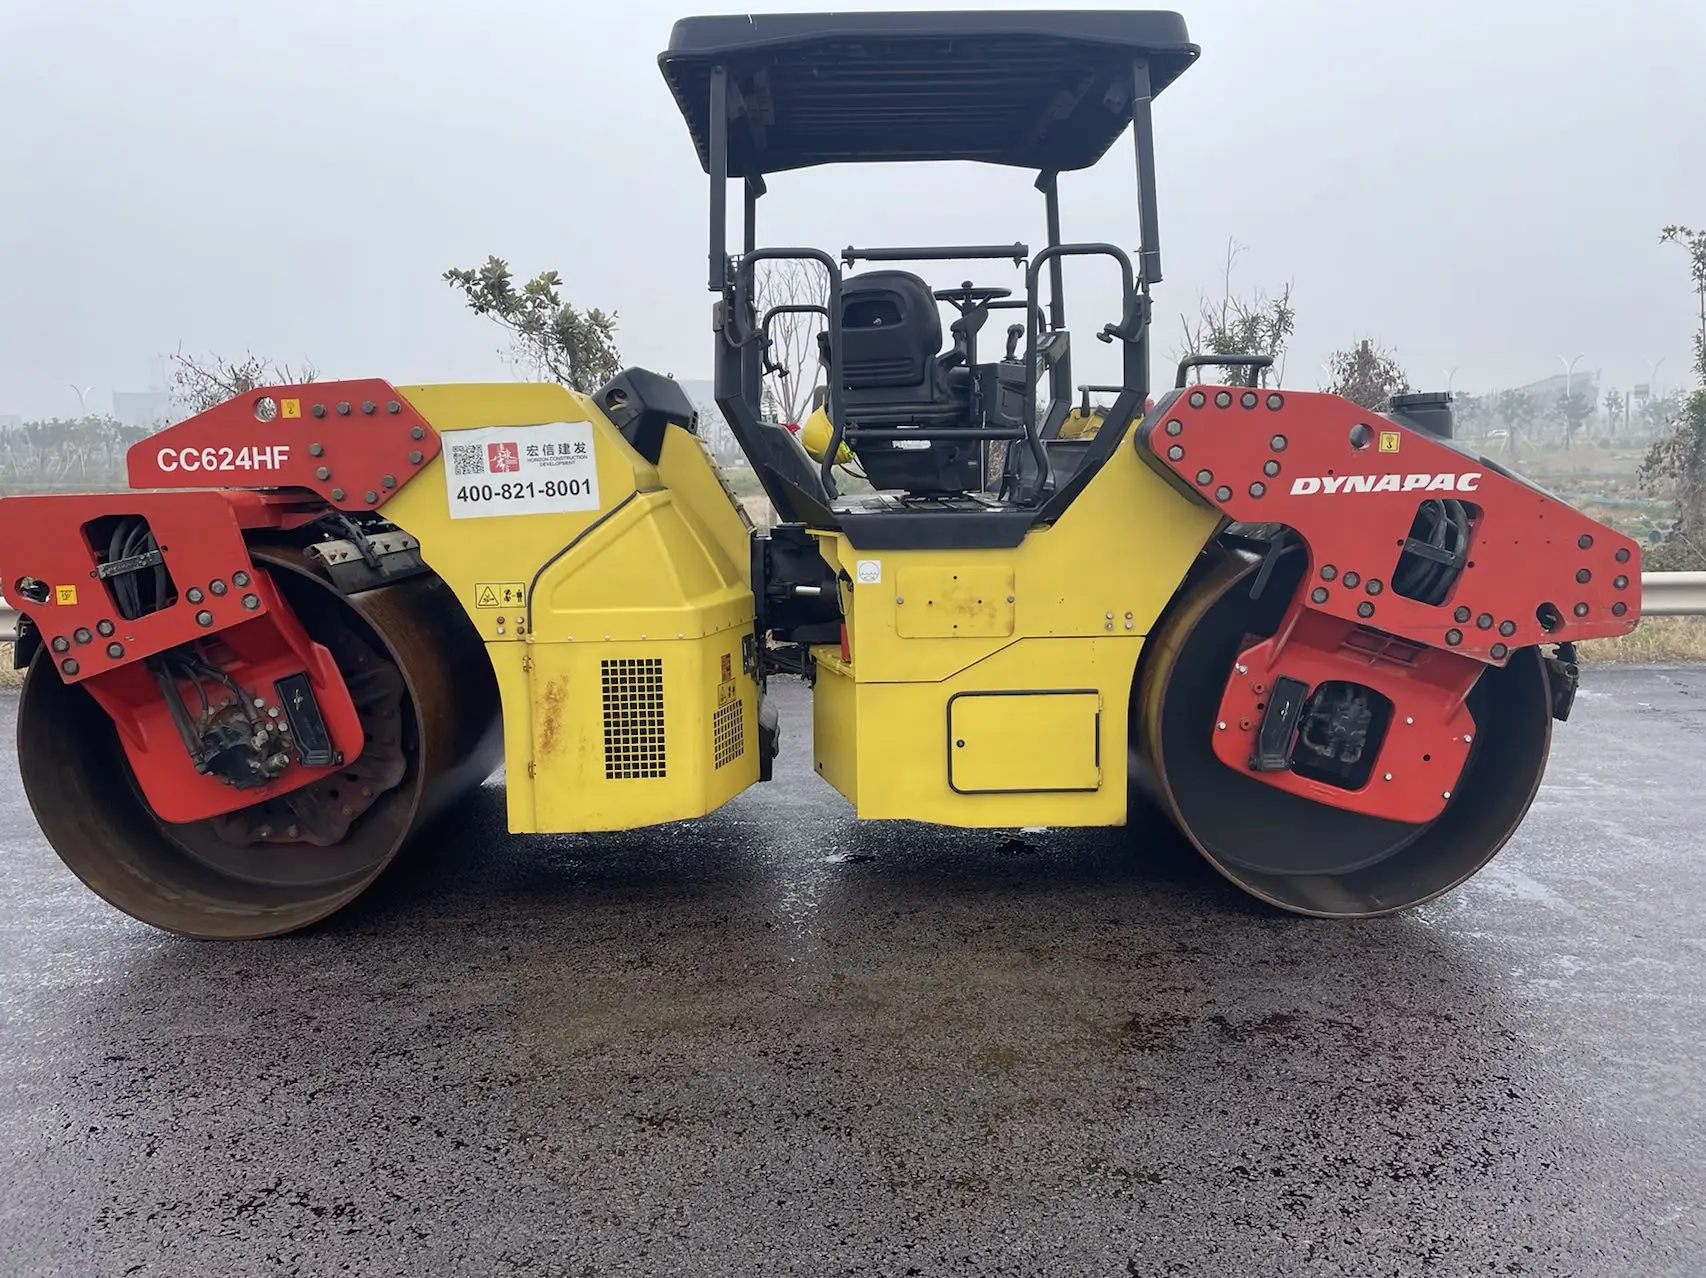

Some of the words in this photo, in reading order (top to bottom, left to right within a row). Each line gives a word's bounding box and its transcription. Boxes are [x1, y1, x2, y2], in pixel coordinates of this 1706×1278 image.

[157, 446, 290, 472] CC624HF
[526, 442, 587, 457] 宏信建发
[457, 478, 591, 502] 400-821-8001
[1290, 472, 1482, 495] DYNAPAC
